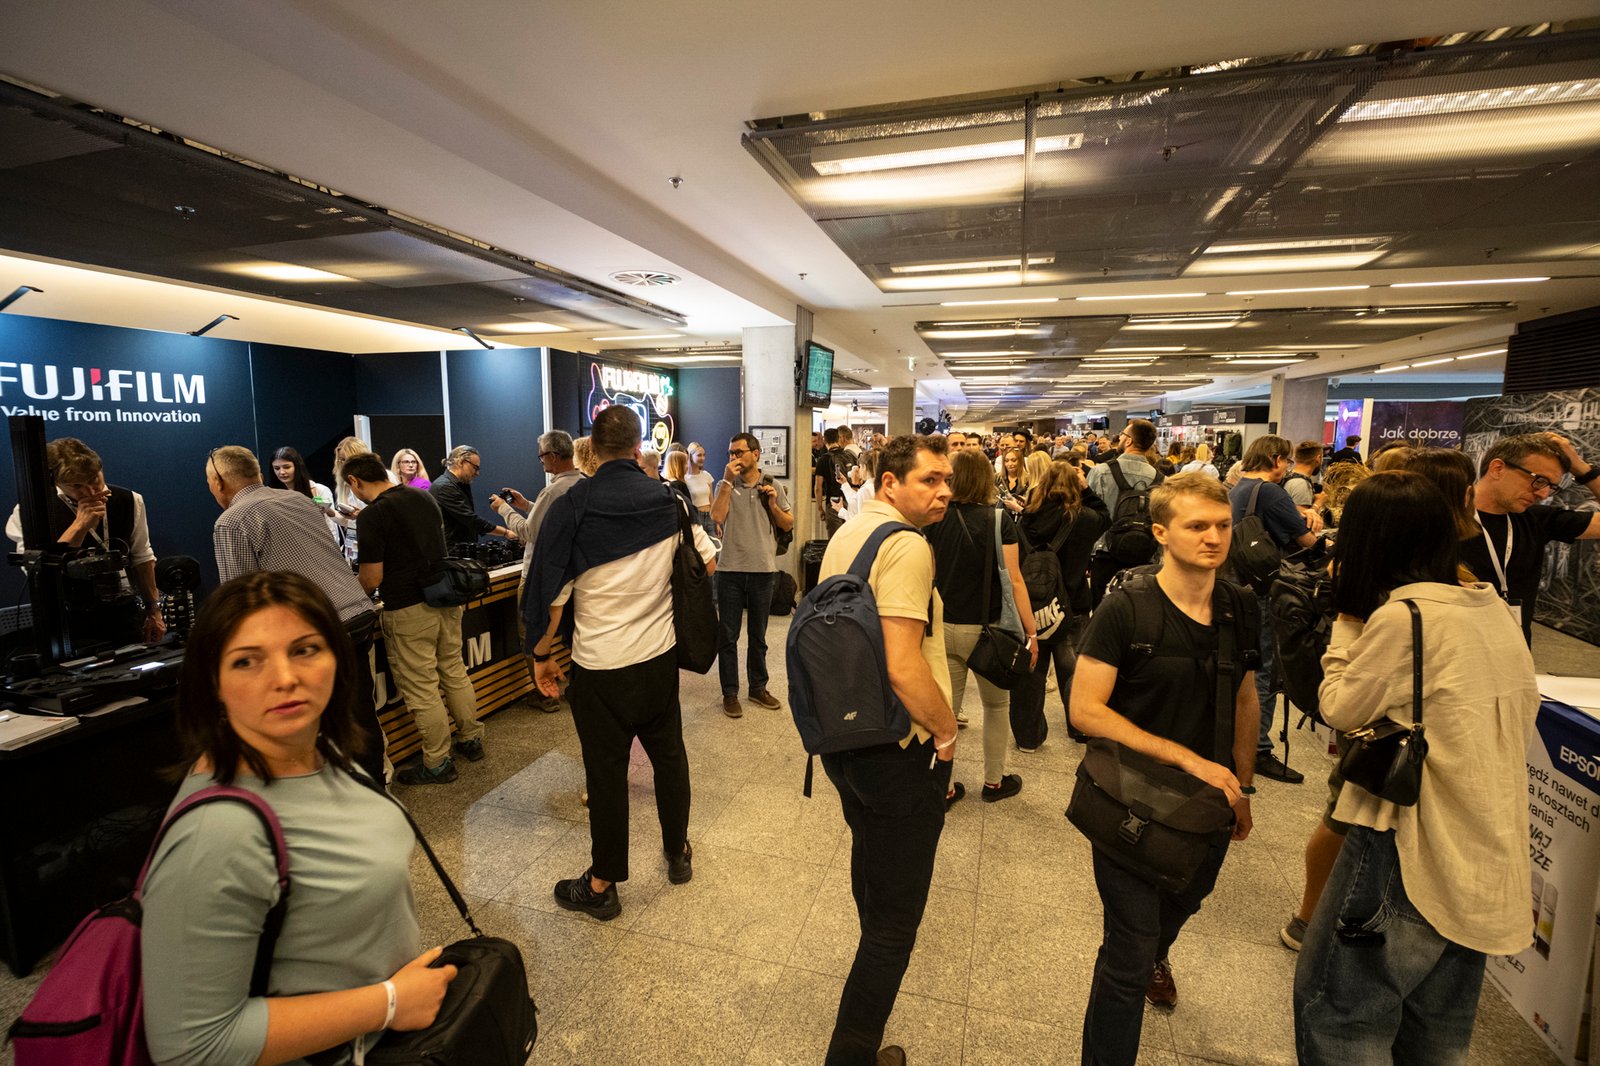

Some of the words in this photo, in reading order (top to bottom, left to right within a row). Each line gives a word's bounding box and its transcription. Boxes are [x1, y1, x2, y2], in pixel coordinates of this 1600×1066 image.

[0, 361, 206, 404] FUJIFILM
[65, 407, 111, 422] from
[116, 409, 201, 423] Innovation
[1380, 427, 1405, 439] Jak
[1409, 428, 1461, 441] dobrze,
[1526, 762, 1550, 786] ędź
[1551, 779, 1588, 811] nawet
[1538, 786, 1590, 833] kosztach
